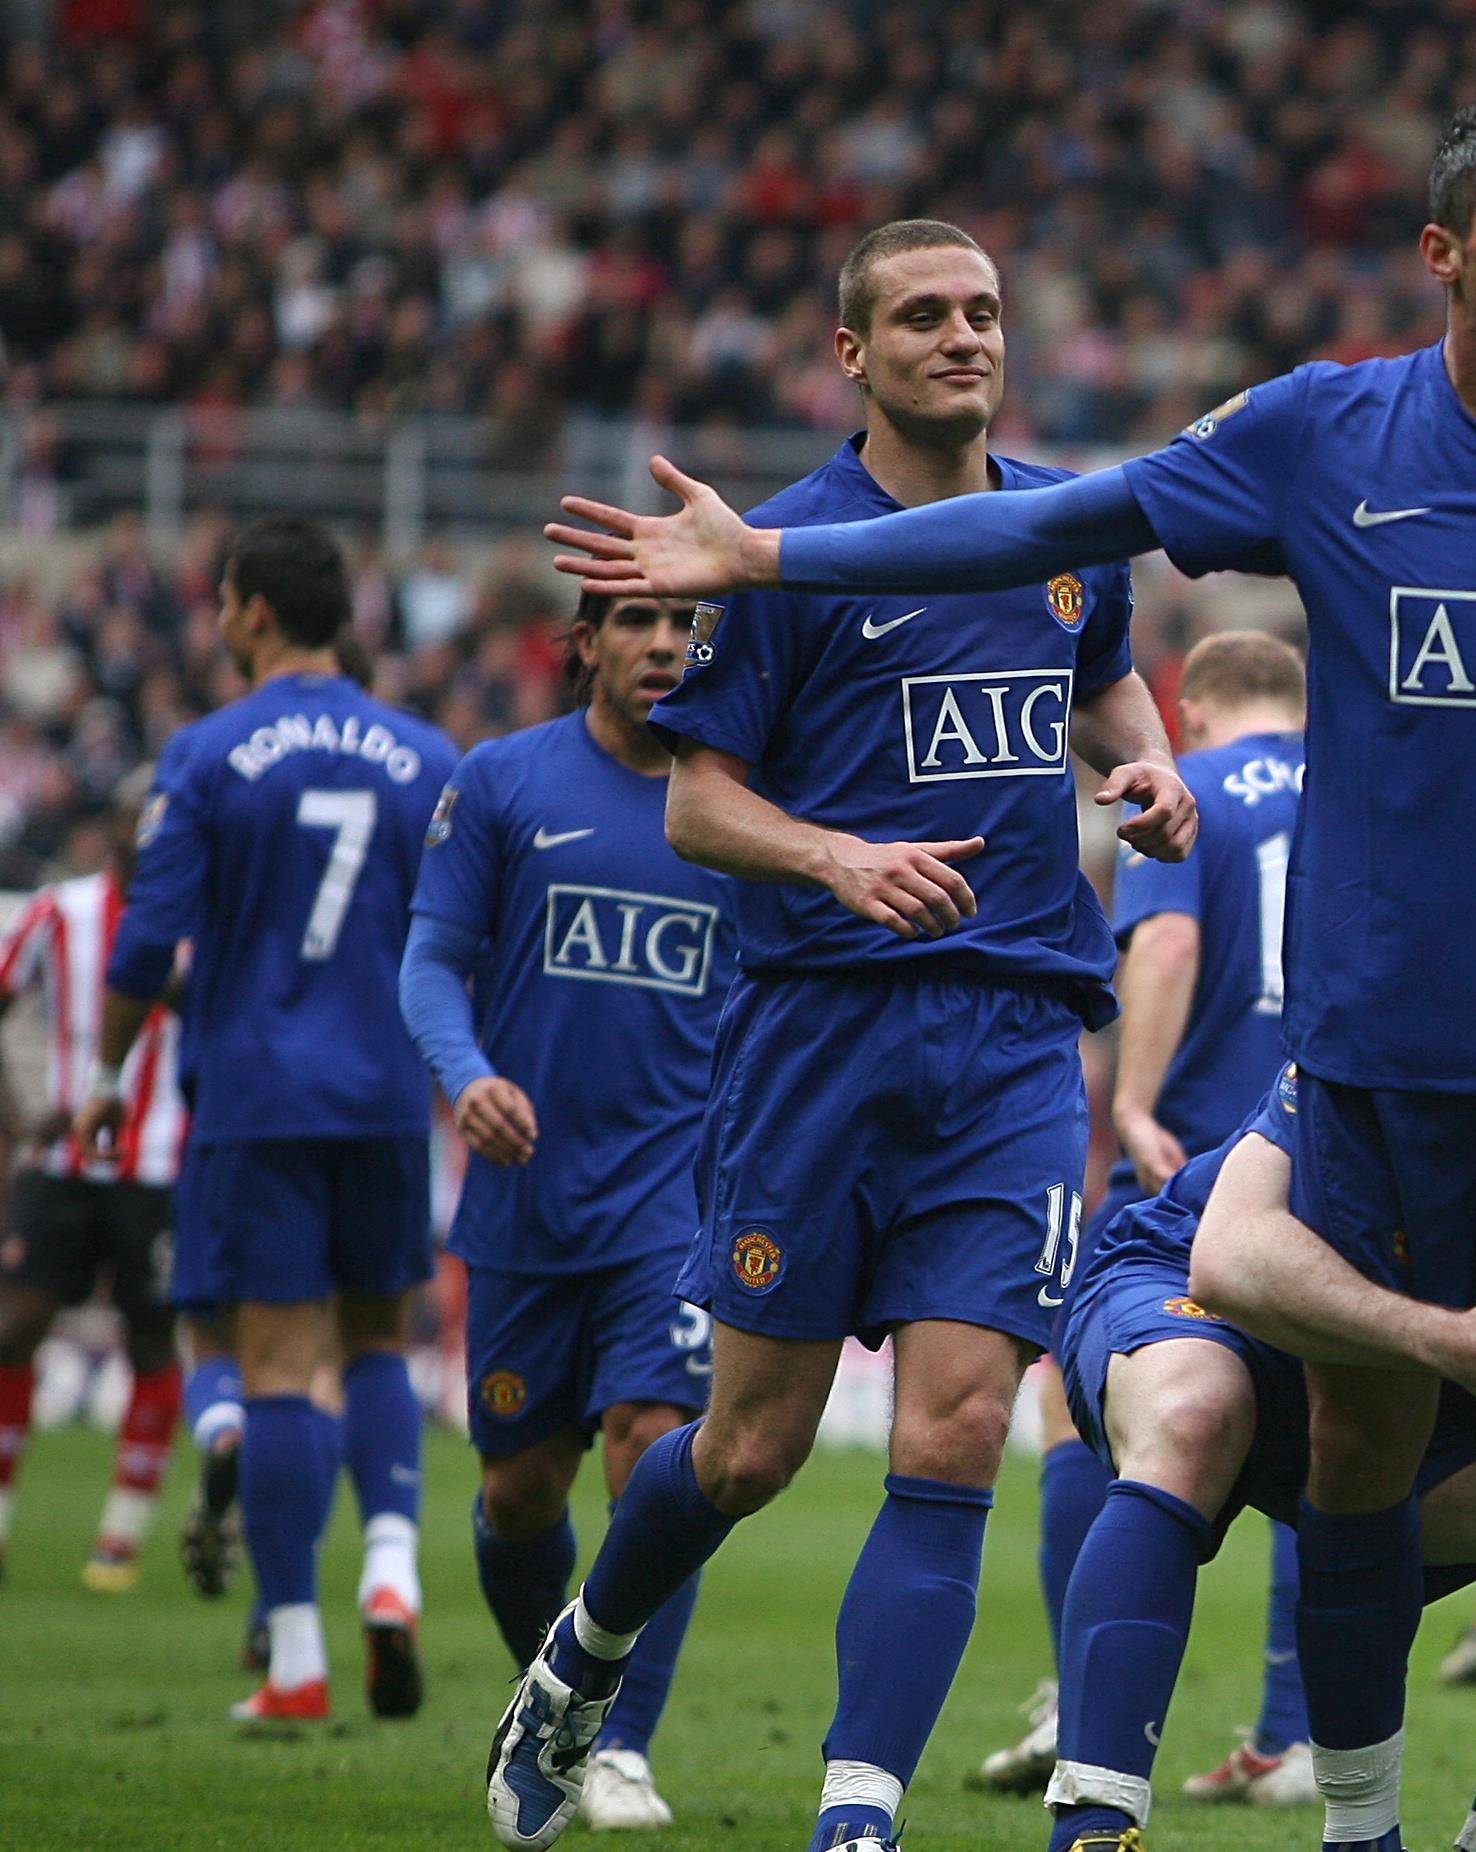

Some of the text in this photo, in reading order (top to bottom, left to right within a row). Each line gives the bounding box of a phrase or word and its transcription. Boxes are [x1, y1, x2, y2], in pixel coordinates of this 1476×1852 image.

[227, 712, 422, 785] RONALDO
[920, 682, 1065, 767] AIG
[296, 788, 378, 961] 7
[554, 897, 701, 982] AIG
